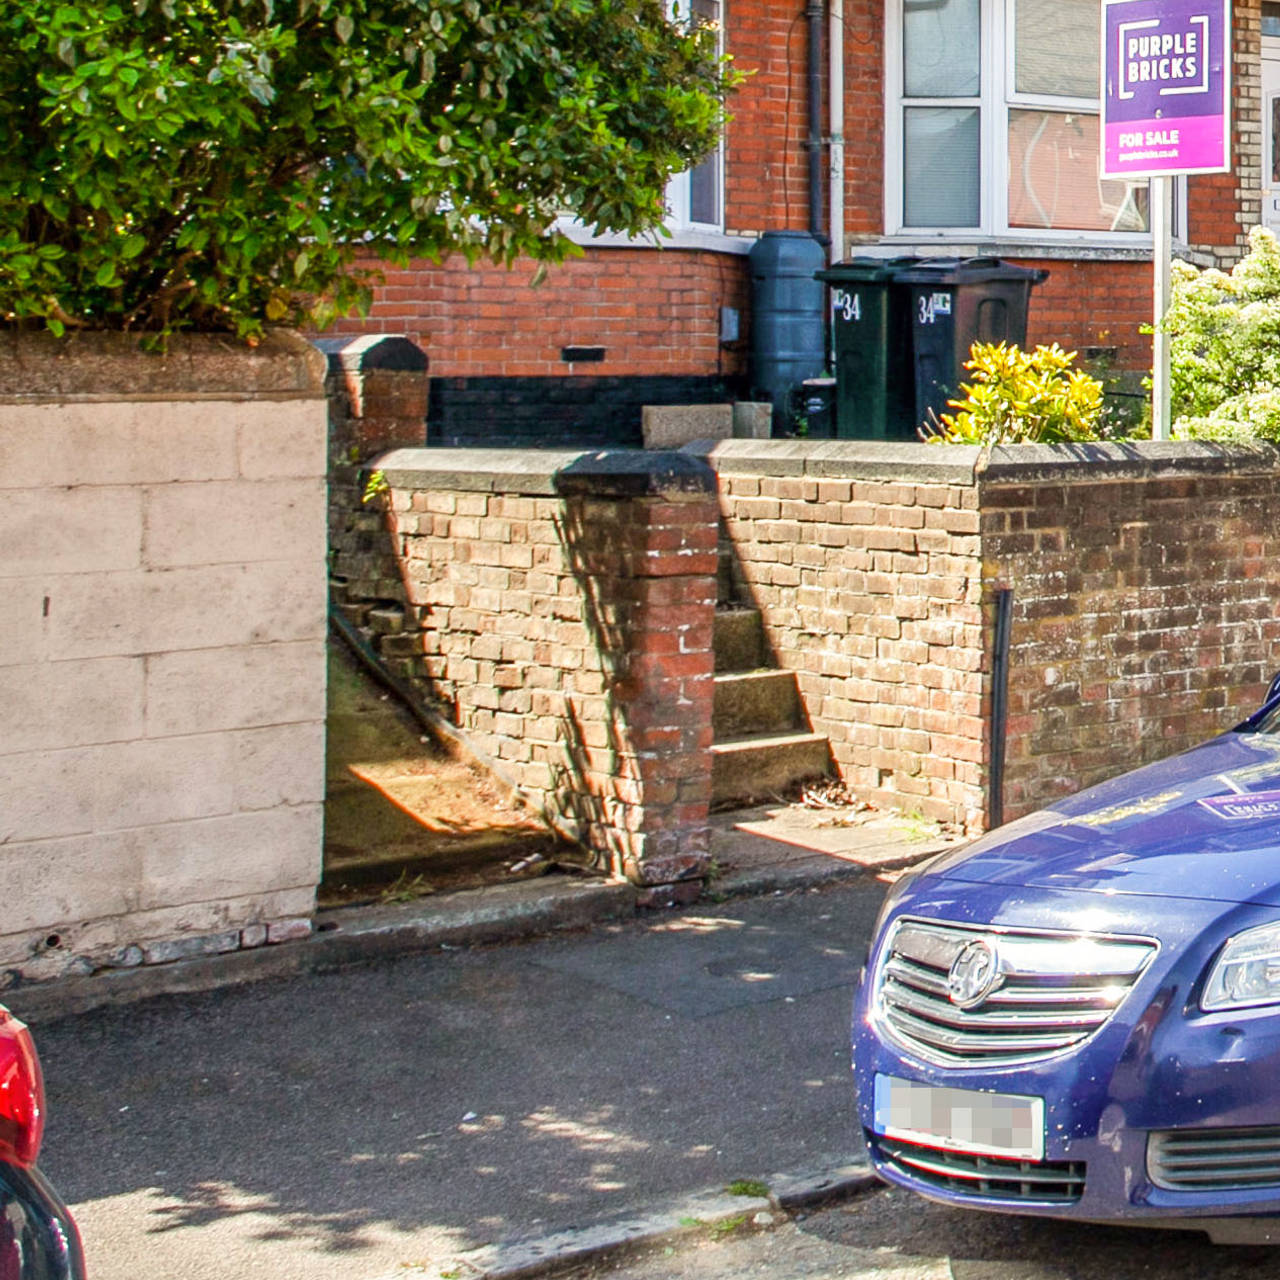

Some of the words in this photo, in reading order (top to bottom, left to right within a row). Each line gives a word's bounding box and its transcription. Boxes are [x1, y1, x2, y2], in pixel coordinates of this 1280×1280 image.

[1128, 32, 1197, 59] PURPLE
[1128, 56, 1197, 82] BRICKS
[1119, 133, 1144, 148] FOR
[1145, 129, 1179, 146] SALE
[843, 293, 860, 321] 34
[919, 295, 935, 324] 34
